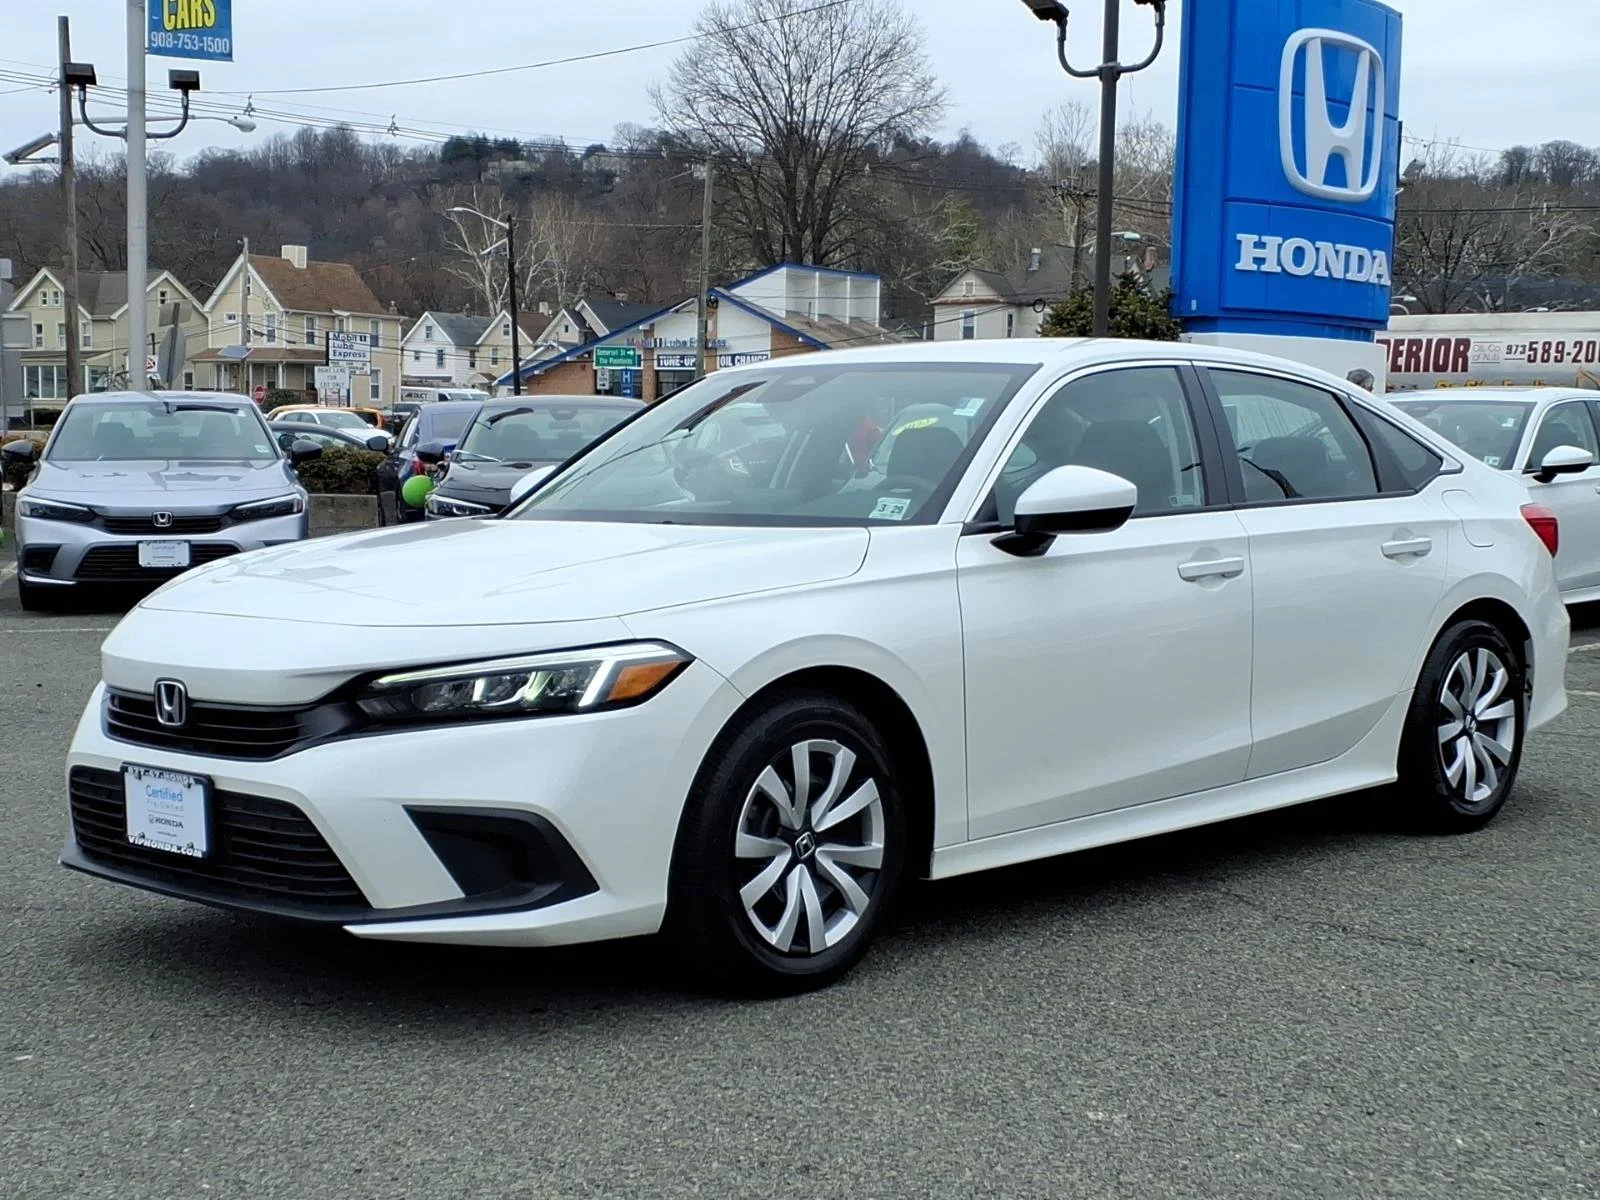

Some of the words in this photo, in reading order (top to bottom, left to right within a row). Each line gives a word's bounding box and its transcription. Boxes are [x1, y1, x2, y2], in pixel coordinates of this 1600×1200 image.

[162, 0, 216, 31] CARS
[150, 31, 230, 53] 908-753-1500
[1235, 233, 1391, 286] HONDA
[332, 333, 357, 343] Mobil
[626, 337, 652, 348] Mobil
[664, 337, 688, 348] Lube
[332, 341, 354, 350] Lube
[1505, 344, 1526, 355] 973
[1527, 340, 1600, 363] 589-20
[332, 350, 367, 358] Express
[658, 354, 696, 367] TUNE-UP
[720, 355, 733, 367] OIL
[622, 370, 631, 384] H
[878, 503, 886, 513] 3
[890, 504, 904, 514] 29
[145, 784, 183, 802] Certified
[155, 816, 184, 829] HONDA
[128, 836, 203, 858] VIPHONDA.COM
